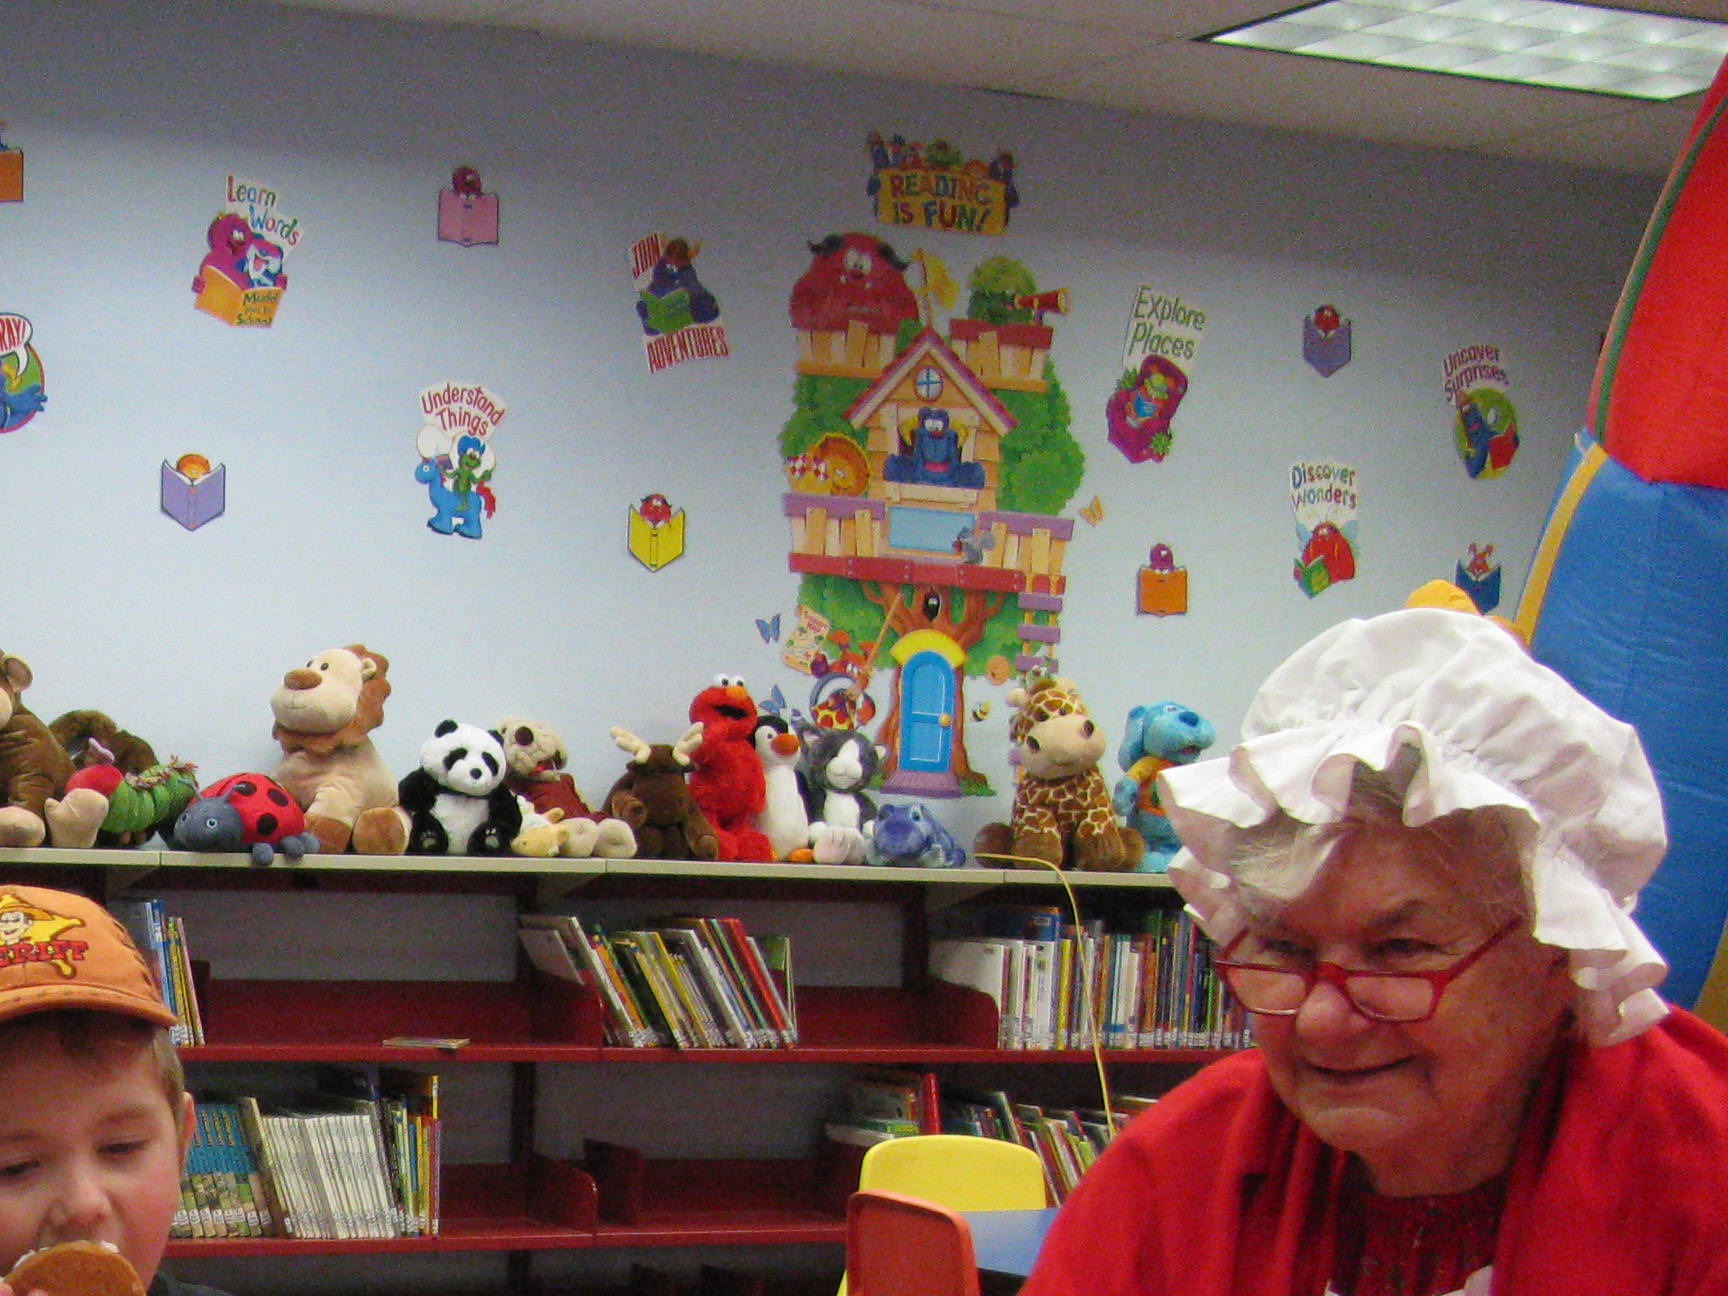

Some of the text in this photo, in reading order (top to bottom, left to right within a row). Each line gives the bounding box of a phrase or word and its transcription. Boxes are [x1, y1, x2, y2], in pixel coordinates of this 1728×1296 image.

[227, 174, 276, 207] Learn
[890, 173, 993, 205] READING
[249, 204, 300, 245] Words
[894, 200, 991, 232] IS FUN!
[1133, 285, 1206, 330] Explore
[1128, 321, 1195, 359] Places
[421, 382, 506, 426] Understand
[436, 406, 488, 436] Things
[1292, 462, 1356, 489] Discover
[1291, 483, 1357, 510] Wonders
